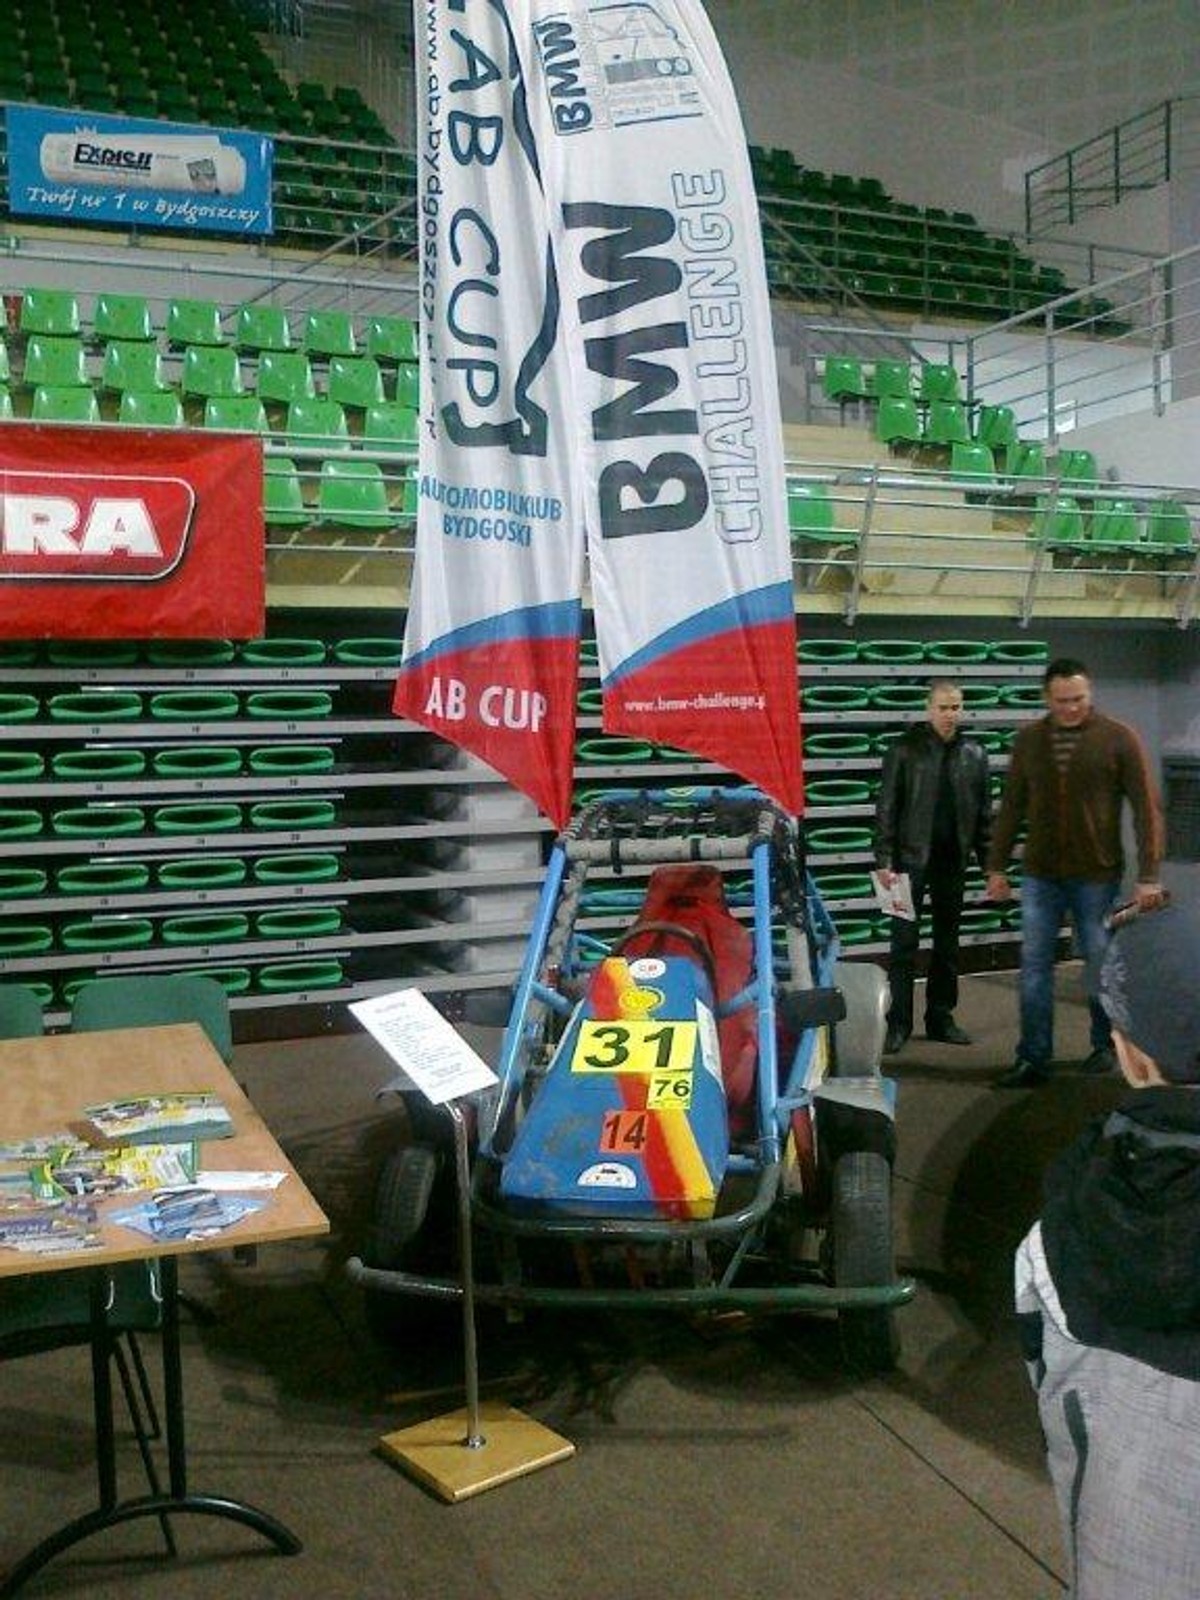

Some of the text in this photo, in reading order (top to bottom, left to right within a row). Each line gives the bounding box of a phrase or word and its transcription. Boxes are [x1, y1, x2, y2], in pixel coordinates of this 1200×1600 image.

[533, 21, 592, 131] BMW
[27, 187, 260, 228] Twój nr 1 w Bydgoszczy
[446, 29, 503, 407] AB CUP
[561, 201, 709, 539] BMW
[672, 169, 762, 545] CHALLENGE
[420, 475, 562, 521] AUTOMOBILKLUB
[443, 513, 531, 547] BYDGOSKI
[424, 676, 547, 732] AB CUP
[624, 692, 766, 711] www.bmw-challenge.p
[584, 1026, 675, 1069] 31
[654, 1079, 690, 1098] 76
[604, 1114, 646, 1150] 14
